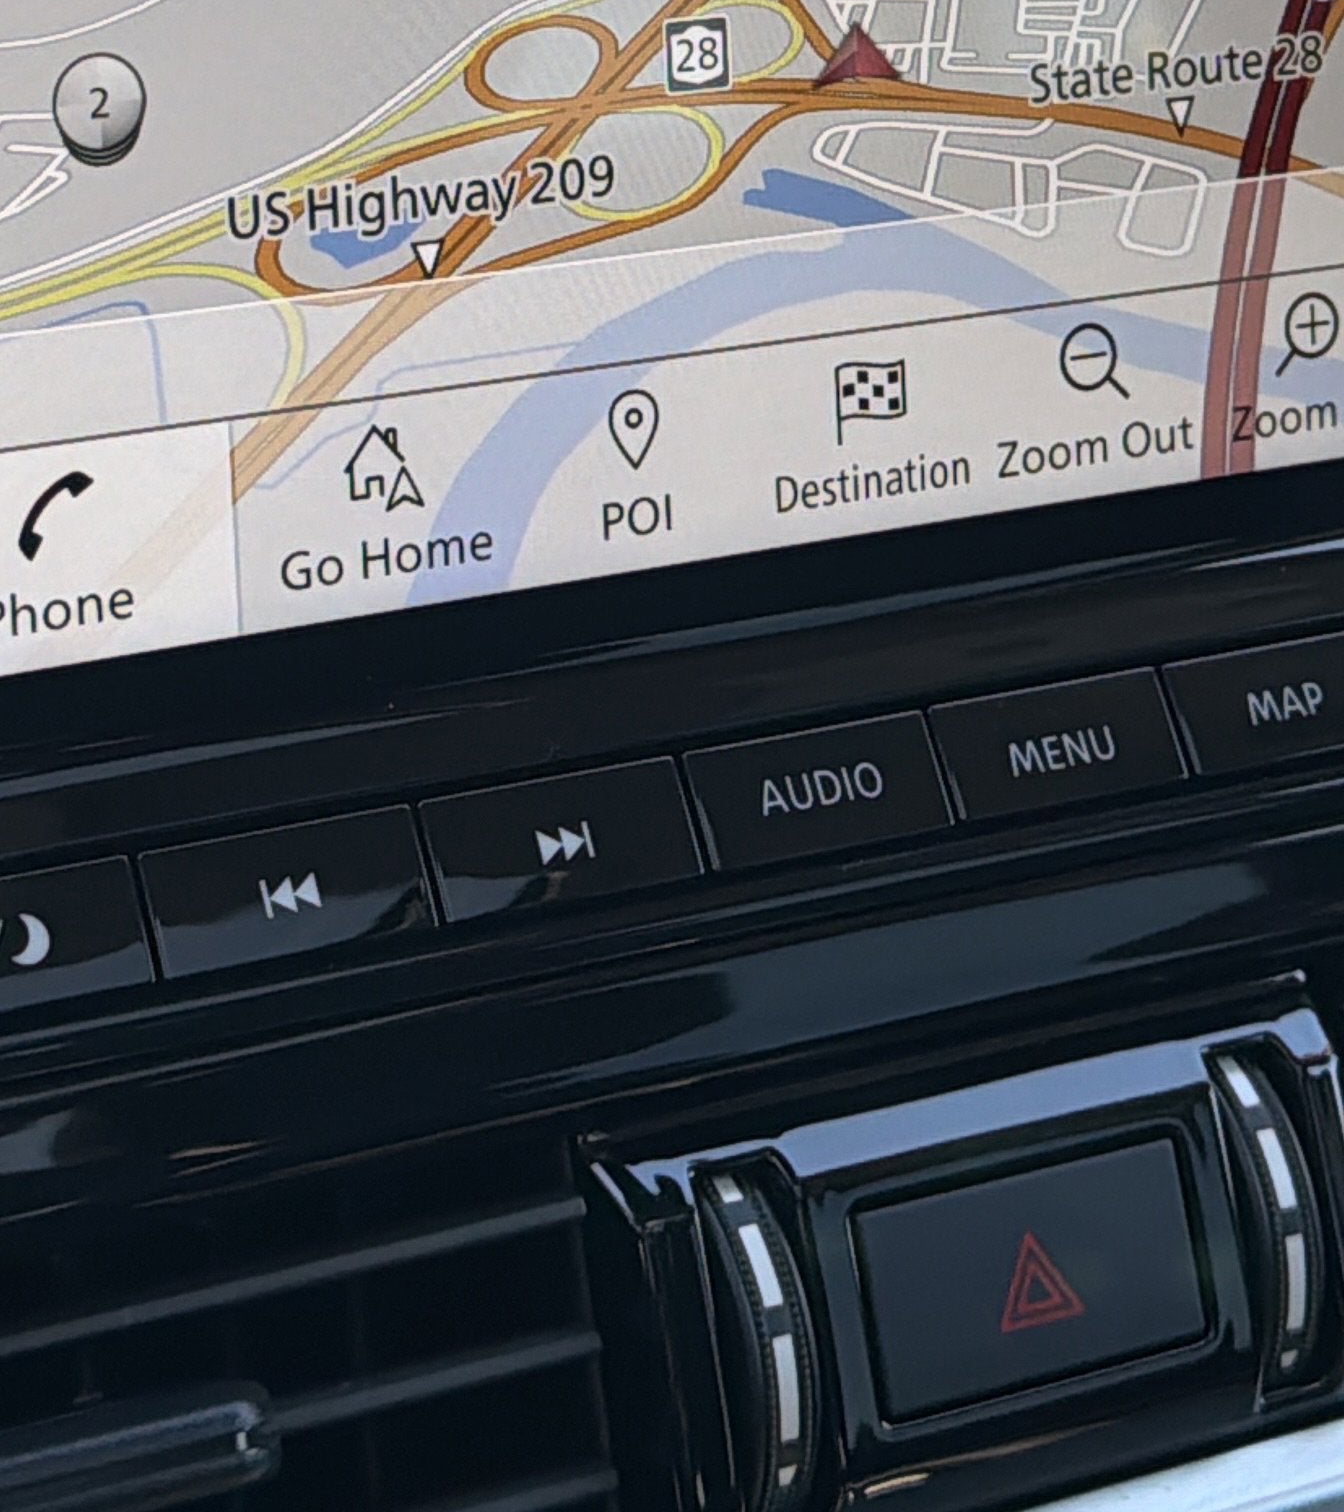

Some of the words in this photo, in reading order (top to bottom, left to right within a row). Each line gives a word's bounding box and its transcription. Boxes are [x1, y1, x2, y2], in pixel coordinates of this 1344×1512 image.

[675, 38, 720, 73] 28
[1030, 61, 1135, 105] State
[1147, 49, 1266, 90] Route
[1274, 37, 1323, 75] 28
[88, 87, 111, 120] 2
[226, 193, 292, 240] US
[307, 173, 517, 238] Highway
[531, 155, 616, 202] 209
[997, 433, 1108, 479] Zoom
[1121, 415, 1194, 458] Out
[1232, 399, 1337, 442] Zoom
[776, 453, 971, 514] Destination
[602, 493, 673, 541] POI
[281, 550, 344, 591] Go
[361, 529, 494, 579] Home
[1246, 680, 1324, 727] MAP
[1008, 724, 1117, 779] MENU
[761, 761, 884, 817] AUDIO
